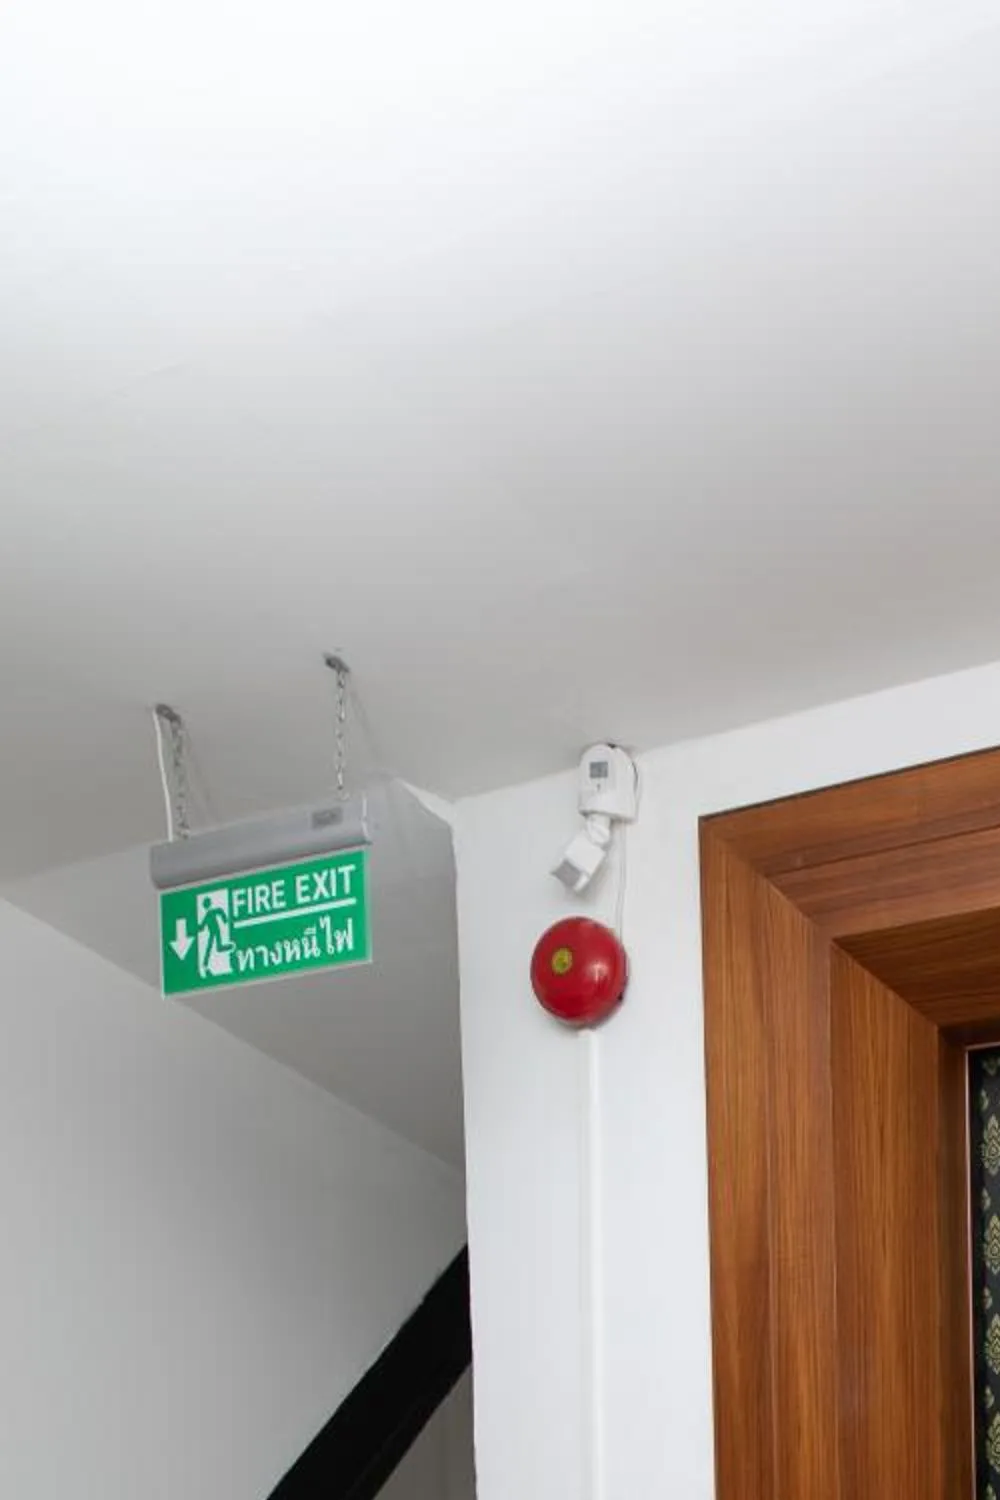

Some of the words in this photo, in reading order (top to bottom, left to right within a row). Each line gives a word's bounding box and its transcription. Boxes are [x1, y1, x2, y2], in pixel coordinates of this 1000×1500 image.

[232, 879, 287, 917] FIRE
[295, 864, 356, 905] EXIT
[236, 914, 354, 972] ทางหนีไฟ
